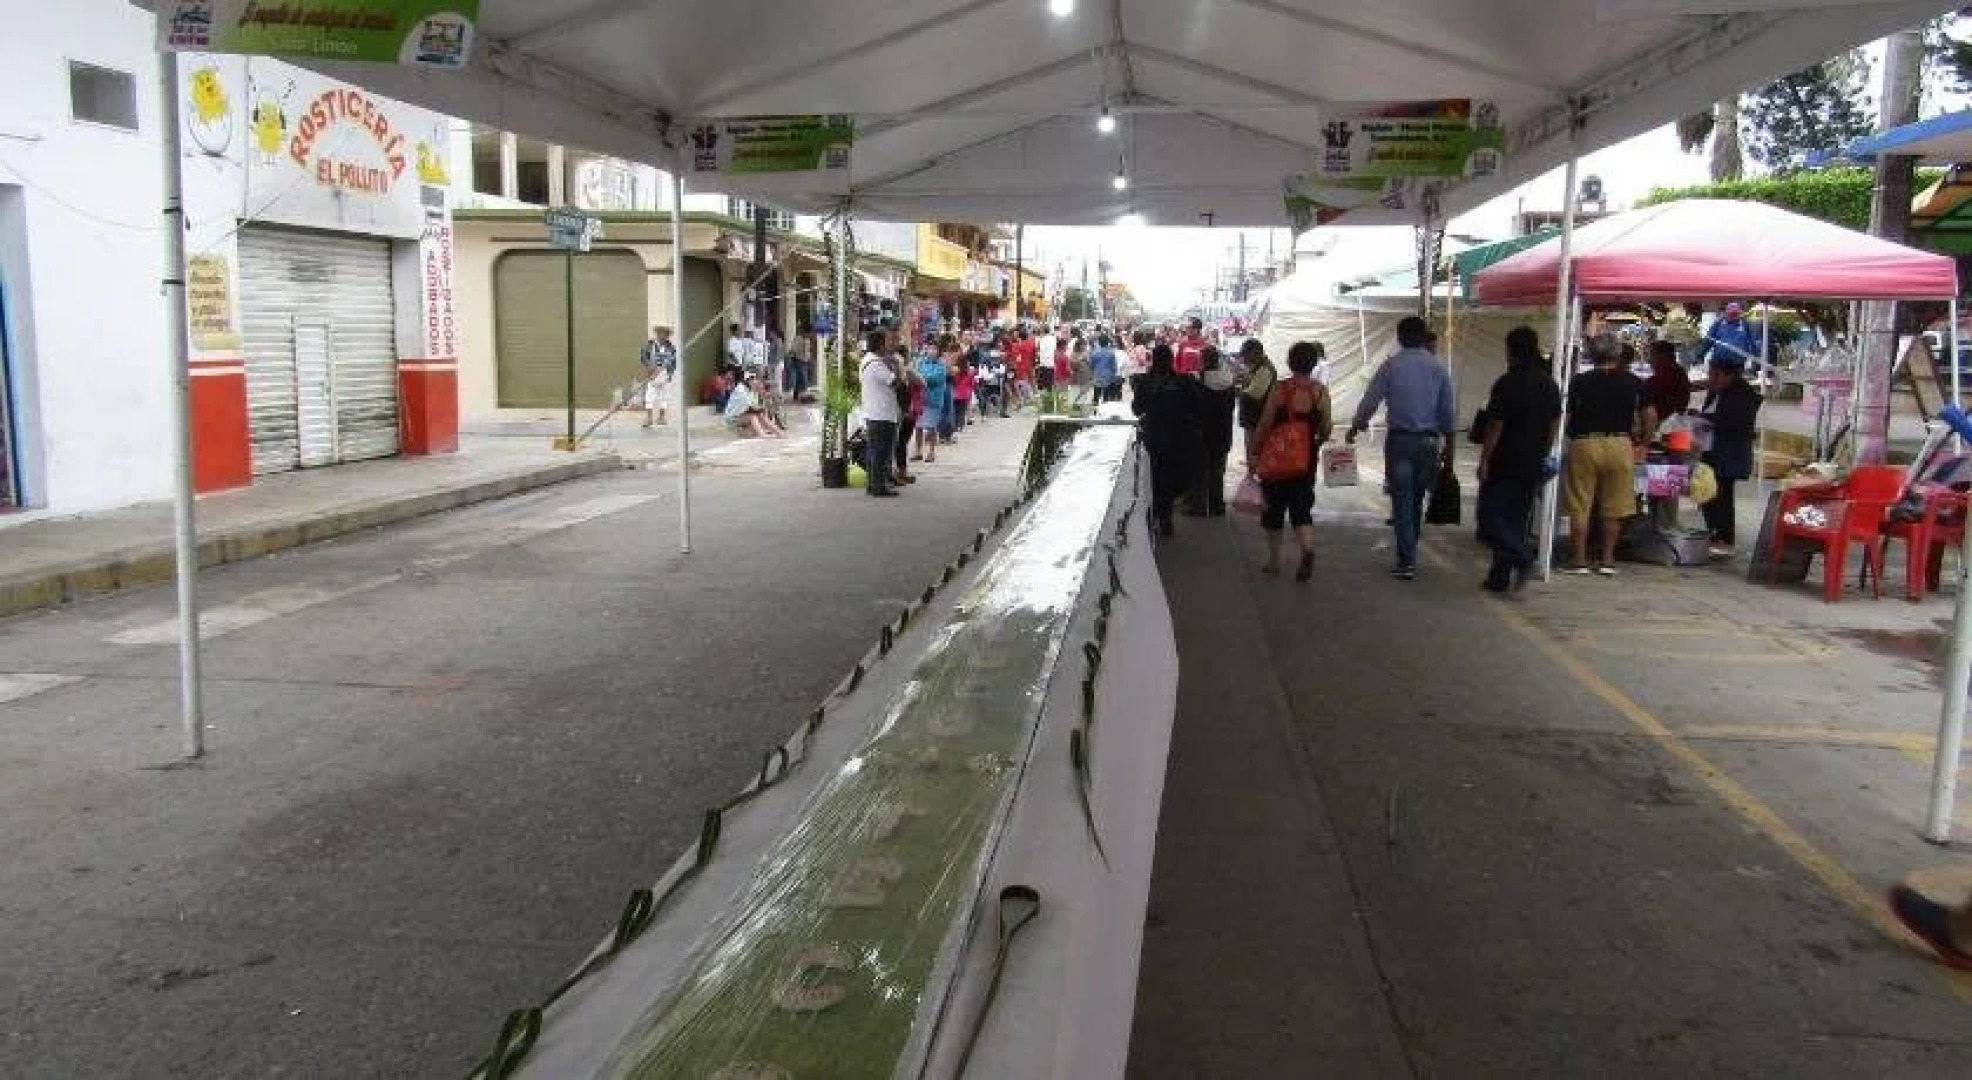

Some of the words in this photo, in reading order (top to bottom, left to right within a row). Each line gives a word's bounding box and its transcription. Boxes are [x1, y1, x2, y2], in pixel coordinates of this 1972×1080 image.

[316, 158, 336, 185] EL
[339, 161, 388, 194] POLLITO
[426, 250, 440, 355] ADOBADOS
